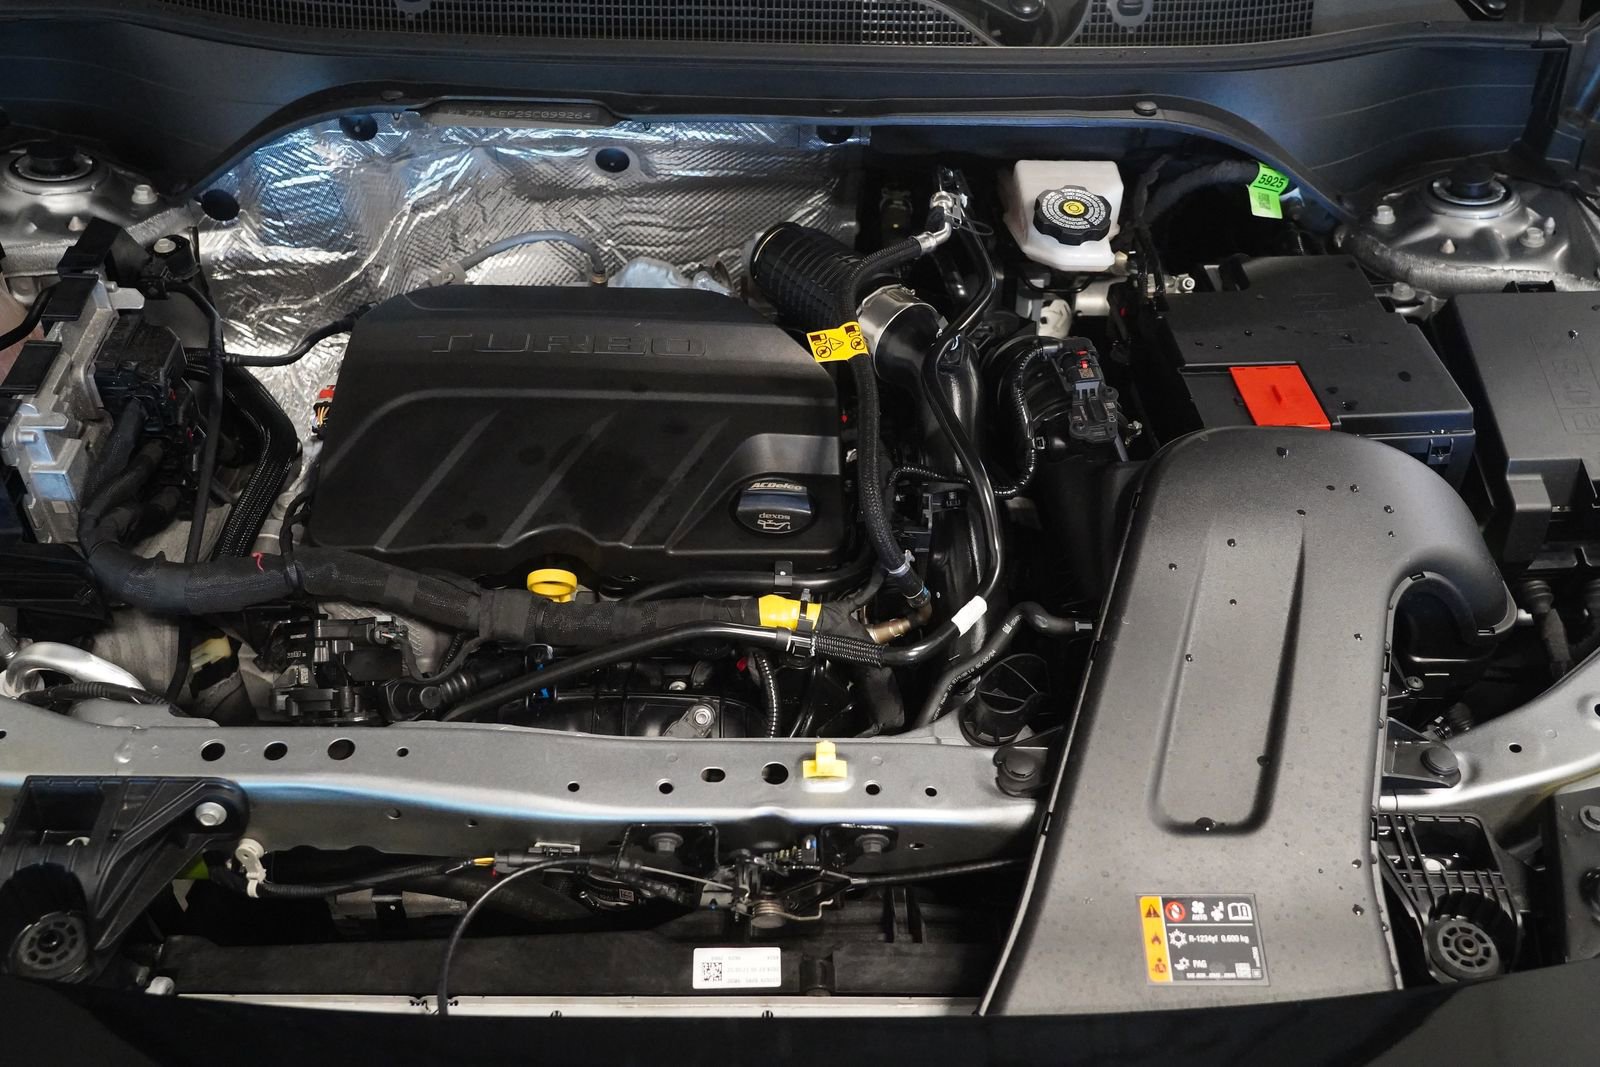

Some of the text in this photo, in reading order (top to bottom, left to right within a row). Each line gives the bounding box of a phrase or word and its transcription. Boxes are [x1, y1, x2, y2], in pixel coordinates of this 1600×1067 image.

[1258, 174, 1286, 188] 5925
[416, 333, 708, 357] TURBO
[751, 482, 802, 492] ACDelco
[758, 512, 791, 520] dexos
[1192, 959, 1208, 969] PAG
